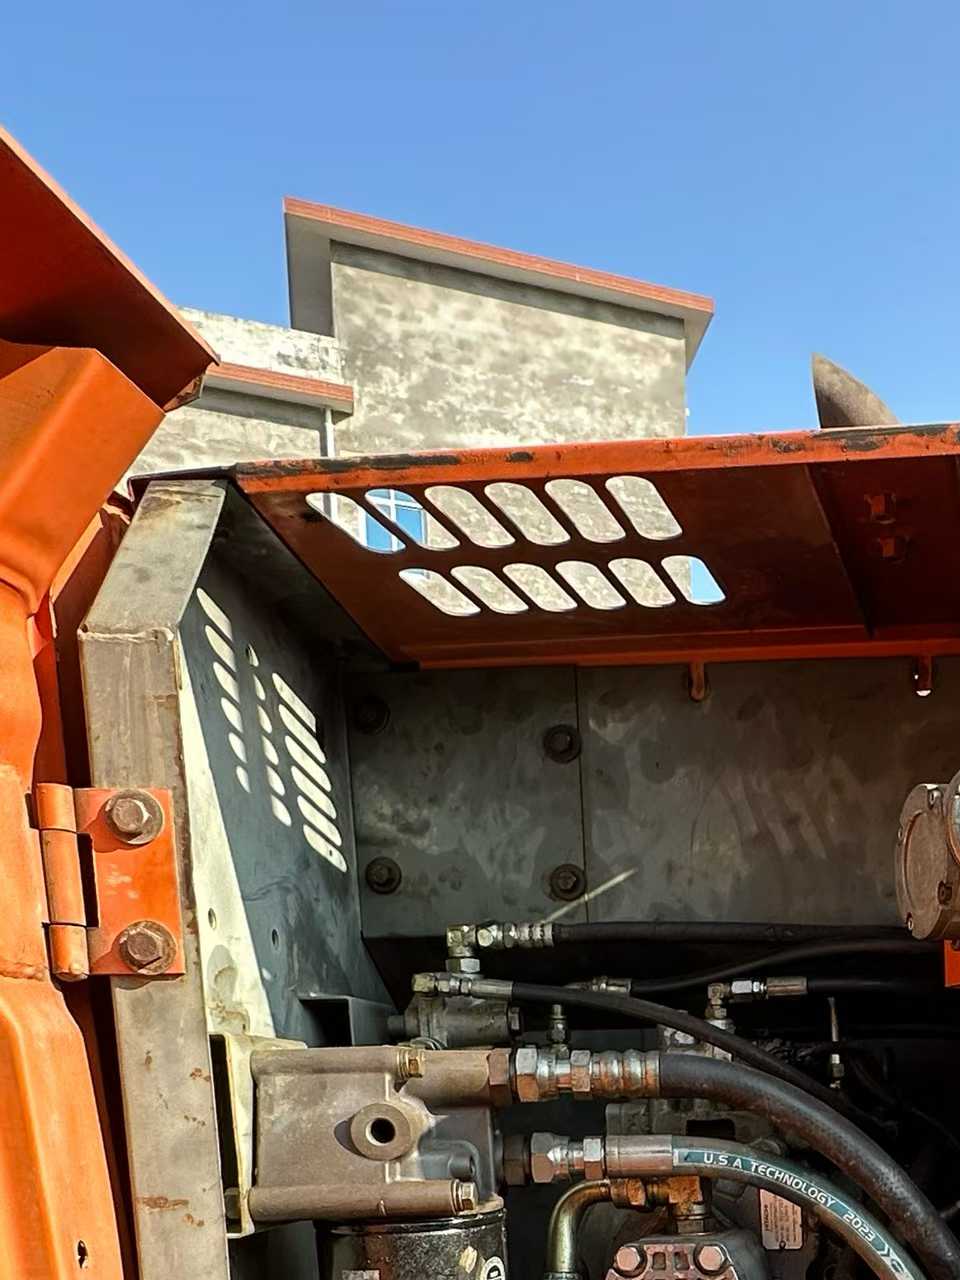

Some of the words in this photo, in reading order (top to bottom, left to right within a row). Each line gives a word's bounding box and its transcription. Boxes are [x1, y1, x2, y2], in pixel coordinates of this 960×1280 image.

[703, 1152, 743, 1169] U.S.A
[750, 1161, 837, 1207] TECHNOLOGY
[843, 1210, 877, 1242] 2023
